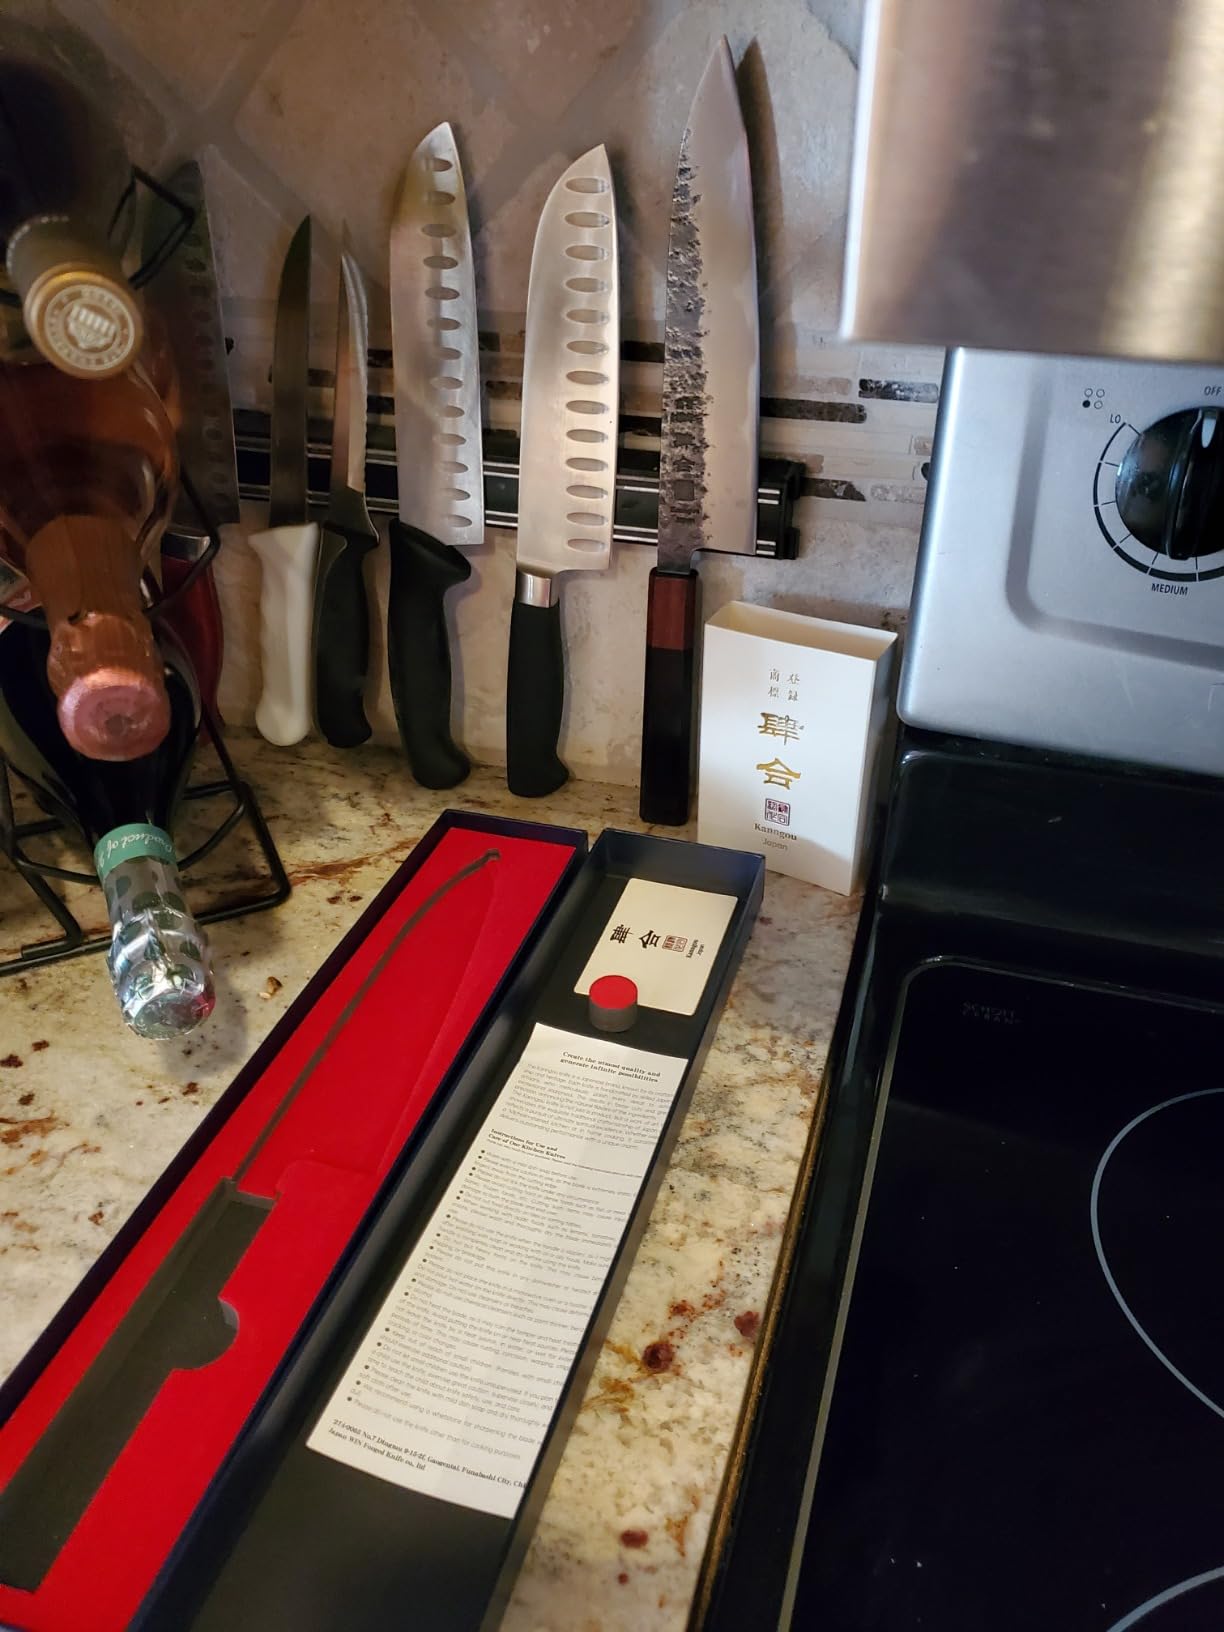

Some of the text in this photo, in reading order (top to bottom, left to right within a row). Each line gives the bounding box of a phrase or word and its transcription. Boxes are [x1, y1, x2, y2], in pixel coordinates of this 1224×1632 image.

[1204, 386, 1222, 396] OFF
[1110, 414, 1121, 424] LO
[1152, 583, 1188, 596] MEDIUM
[754, 823, 797, 841] Kanngou
[562, 1051, 583, 1060] Create
[621, 1065, 645, 1073] quality
[560, 1057, 589, 1067] generate
[618, 1071, 658, 1083] possibilities
[460, 1466, 496, 1481] Funabashi
